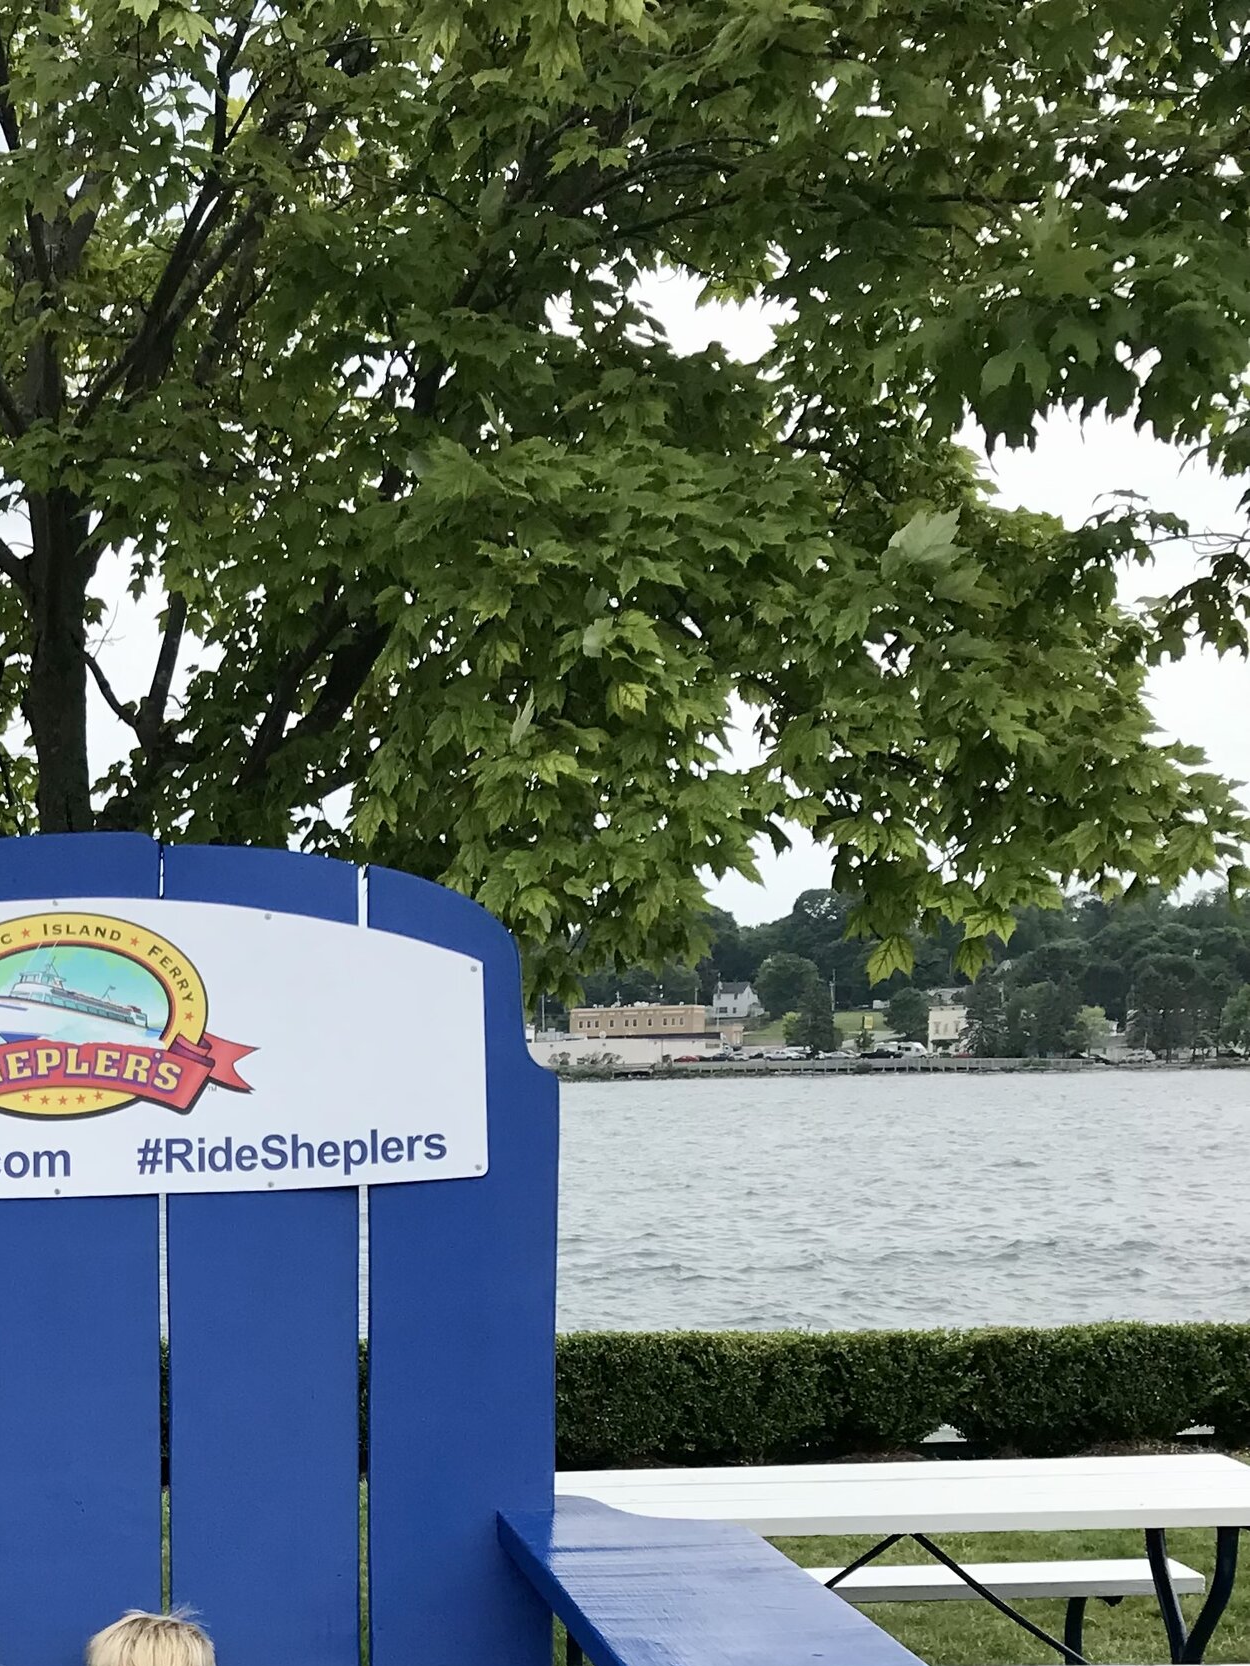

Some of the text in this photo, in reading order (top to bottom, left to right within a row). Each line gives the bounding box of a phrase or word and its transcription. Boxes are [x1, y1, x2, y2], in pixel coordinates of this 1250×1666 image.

[41, 922, 123, 942] ISLAND
[147, 944, 195, 1003] FERRY
[137, 1129, 447, 1175] #RideSheplers
